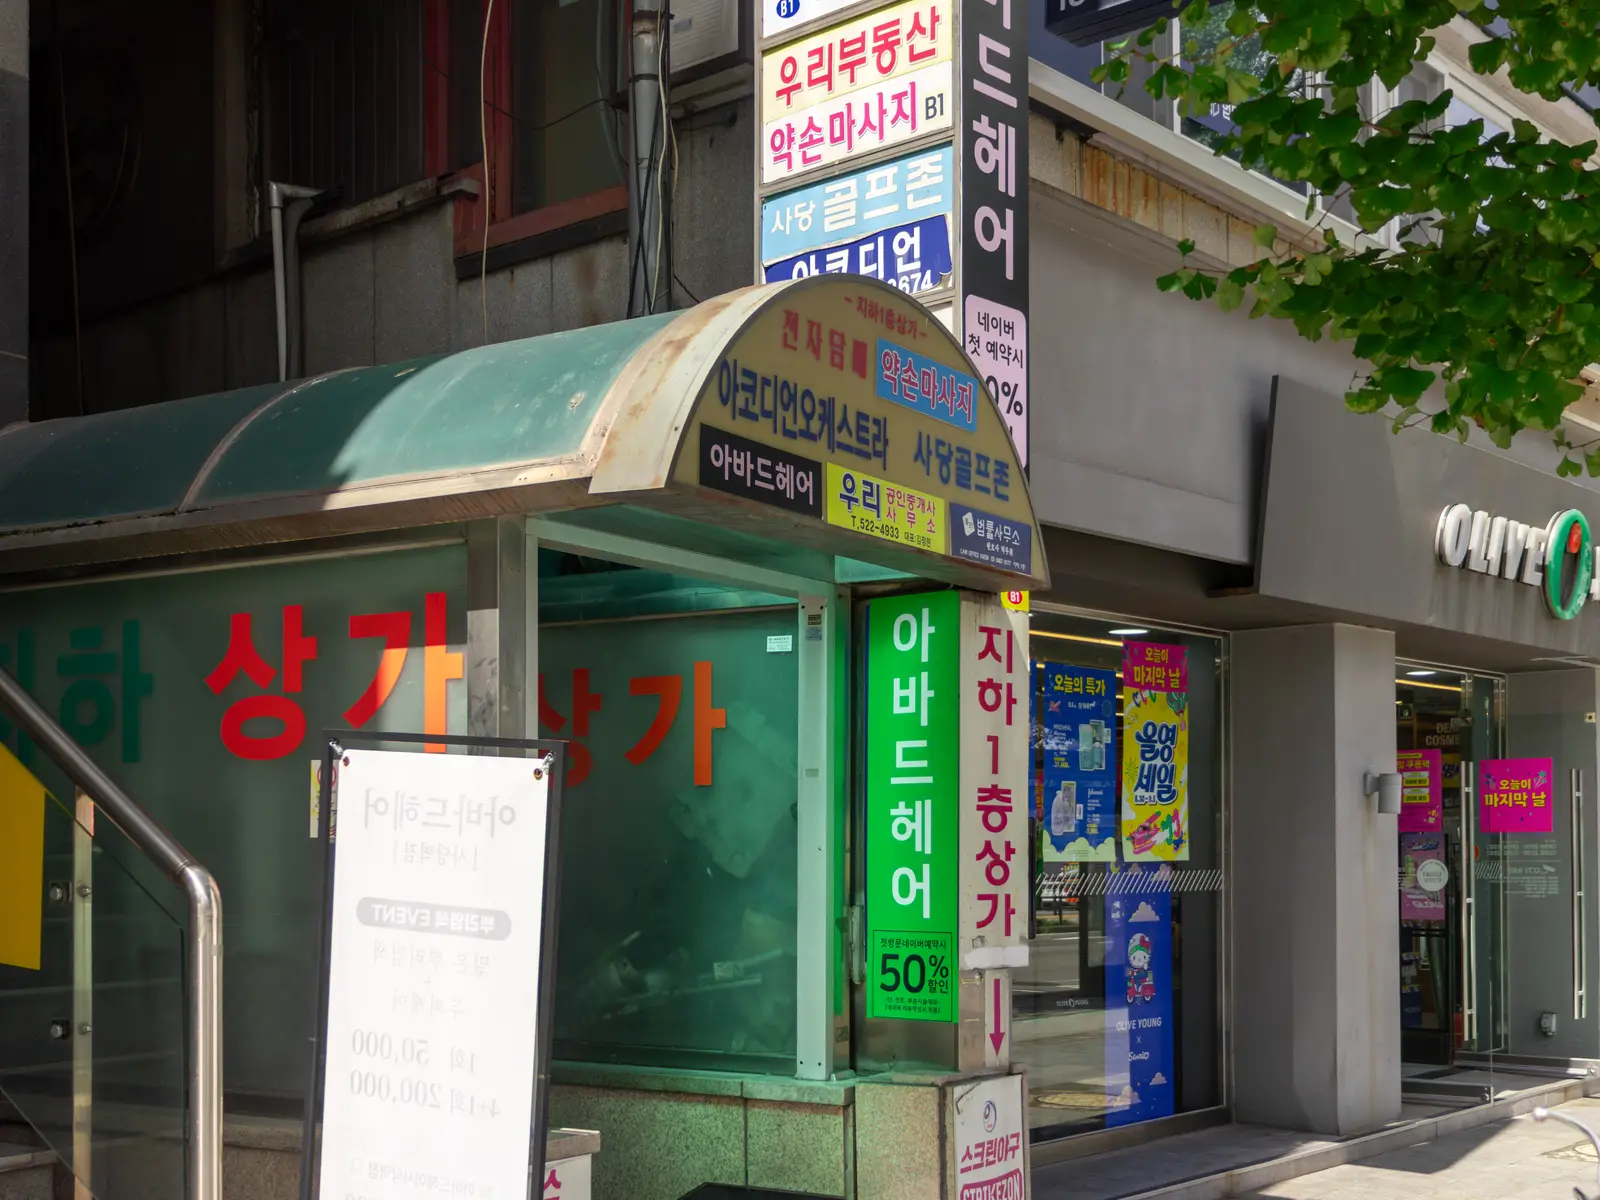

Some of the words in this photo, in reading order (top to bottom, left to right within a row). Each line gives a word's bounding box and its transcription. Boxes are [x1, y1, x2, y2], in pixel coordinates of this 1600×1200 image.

[780, 0, 794, 15] B1
[775, 6, 940, 106] 우리부동산
[770, 81, 917, 171] 약손마사지
[925, 93, 944, 120] B1
[771, 201, 815, 235] 사당
[823, 153, 943, 233] 골프존
[978, 312, 1015, 340] 네이버
[968, 333, 980, 357] 첫
[986, 341, 1023, 368] 예약시
[881, 349, 973, 423] 약손마사지
[718, 358, 889, 471] 아코디언오케스트라
[710, 443, 813, 505] 아바드헤어
[839, 472, 881, 520] 우리
[886, 487, 936, 516] 공인중개사
[851, 515, 900, 540] T.522-4933
[976, 518, 1020, 546] 법률사무소
[1434, 502, 1545, 587] OLIVE
[1010, 591, 1020, 603] B1
[1145, 647, 1169, 663] 오늘이
[205, 592, 463, 760] 상가
[1053, 674, 1083, 694] 오늘의
[1085, 676, 1106, 697] 특가
[1133, 665, 1165, 688] 마지막
[1168, 668, 1181, 688] 날
[1135, 720, 1177, 763] 올영
[890, 607, 935, 919] 아바드헤어
[975, 625, 1016, 937] 지하1층상가
[1133, 763, 1177, 804] 세일
[1484, 792, 1528, 807] 마지막
[1532, 791, 1546, 807] 날
[1499, 778, 1531, 791] 오늘이
[880, 953, 949, 994] 50%
[928, 979, 949, 994] 할인
[1116, 1019, 1136, 1031] OLIVE
[1138, 1017, 1162, 1028] YOUNG
[1128, 1051, 1149, 1062] Sanrio
[960, 1132, 1020, 1174] 스크린야구
